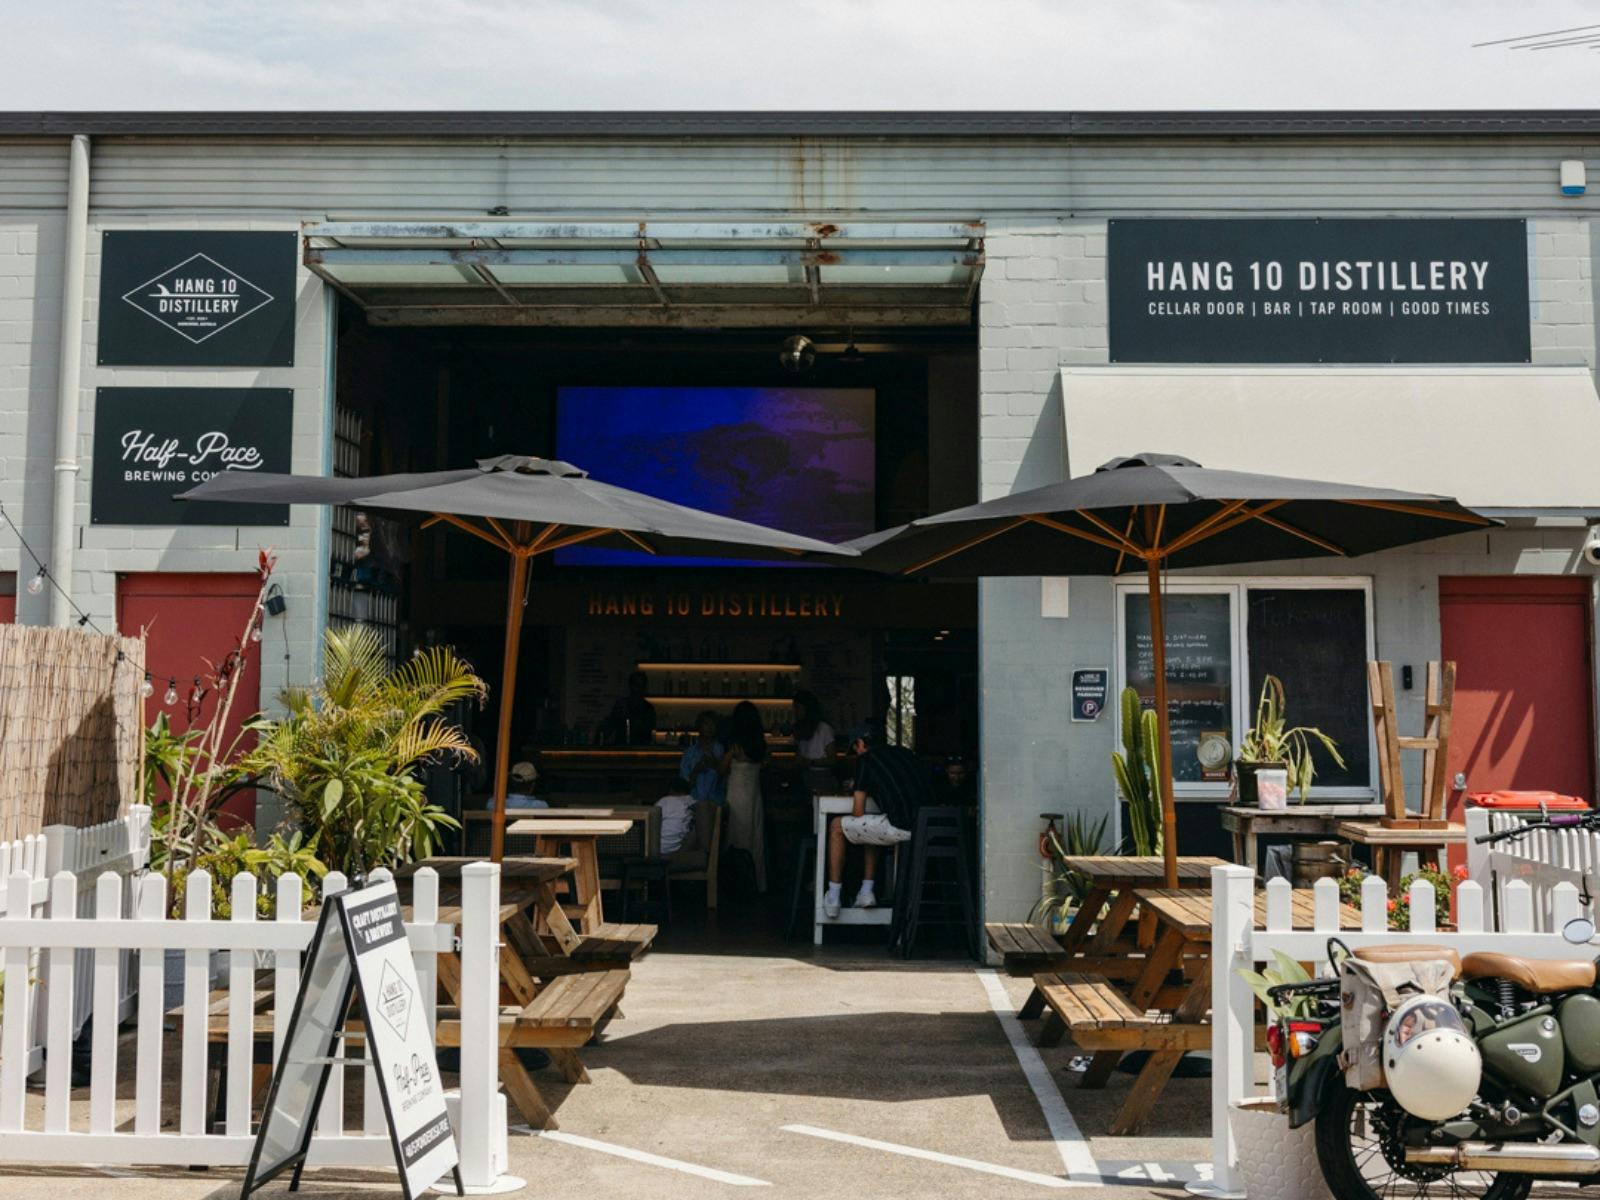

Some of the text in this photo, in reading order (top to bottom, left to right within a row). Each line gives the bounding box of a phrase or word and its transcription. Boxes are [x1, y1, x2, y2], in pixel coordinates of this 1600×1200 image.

[1147, 261, 1489, 291] HANG 10 DISTILLERY
[175, 278, 237, 294] HANG 10
[159, 299, 239, 313] DISTILLERY
[1148, 301, 1200, 316] CELLAR
[1207, 301, 1244, 316] DOOR
[1264, 301, 1291, 316] BAR
[1310, 301, 1336, 316] TAP
[1343, 301, 1382, 316] ROOM
[1402, 301, 1440, 316] GOOD
[1446, 301, 1490, 316] TIMES
[121, 430, 264, 470] Half-Pace
[124, 470, 221, 482] BREWING COM
[588, 591, 844, 617] HANG 10 DISTILLERY
